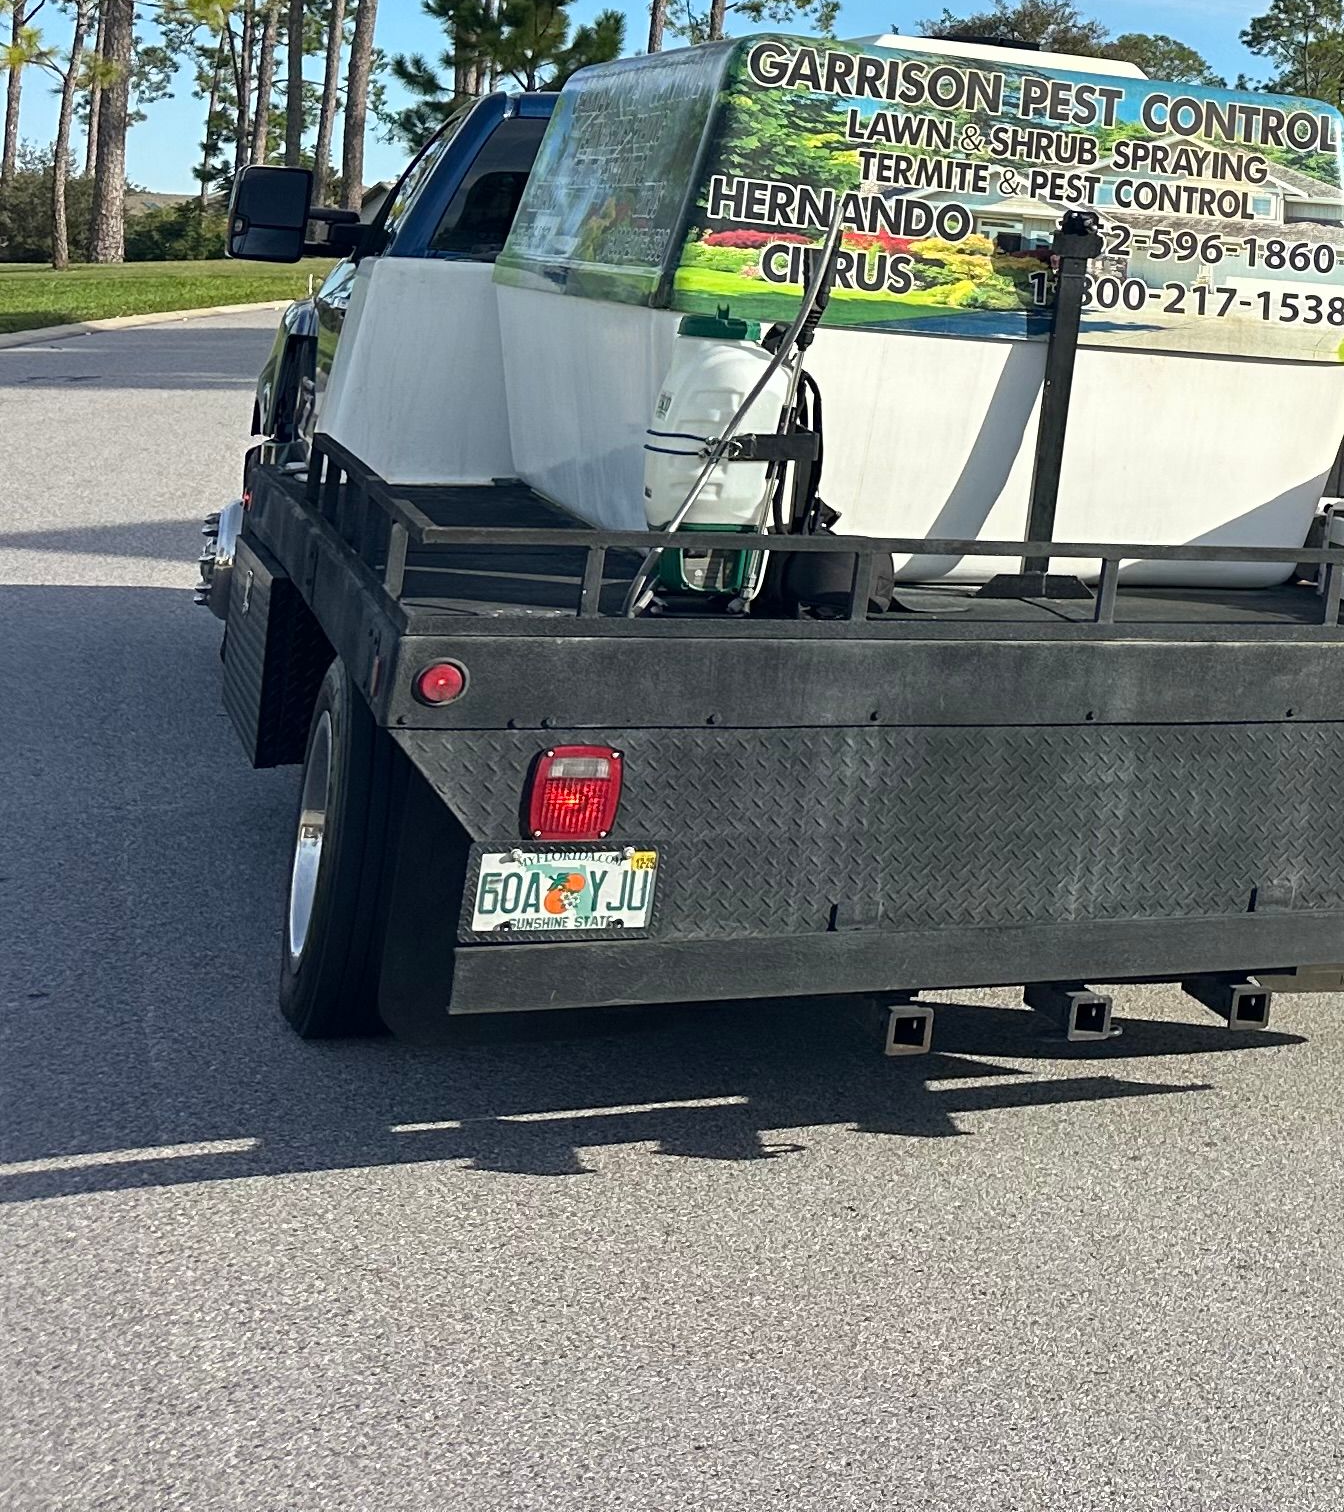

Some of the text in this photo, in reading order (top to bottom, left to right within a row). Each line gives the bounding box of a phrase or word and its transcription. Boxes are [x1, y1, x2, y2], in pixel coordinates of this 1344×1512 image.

[748, 42, 1003, 115] GARRISON
[1020, 78, 1122, 128] PEST
[1142, 94, 1338, 154] CONTROL
[849, 109, 1268, 184] LAWN & SHRUB SPRAYING
[708, 177, 972, 241] HERNANDO
[859, 151, 1254, 220] TERMITE & PEST CONTROL
[761, 243, 916, 294] CIRUS
[1059, 223, 1336, 276] 2-596-1860
[509, 916, 568, 930] SUNSHINE
